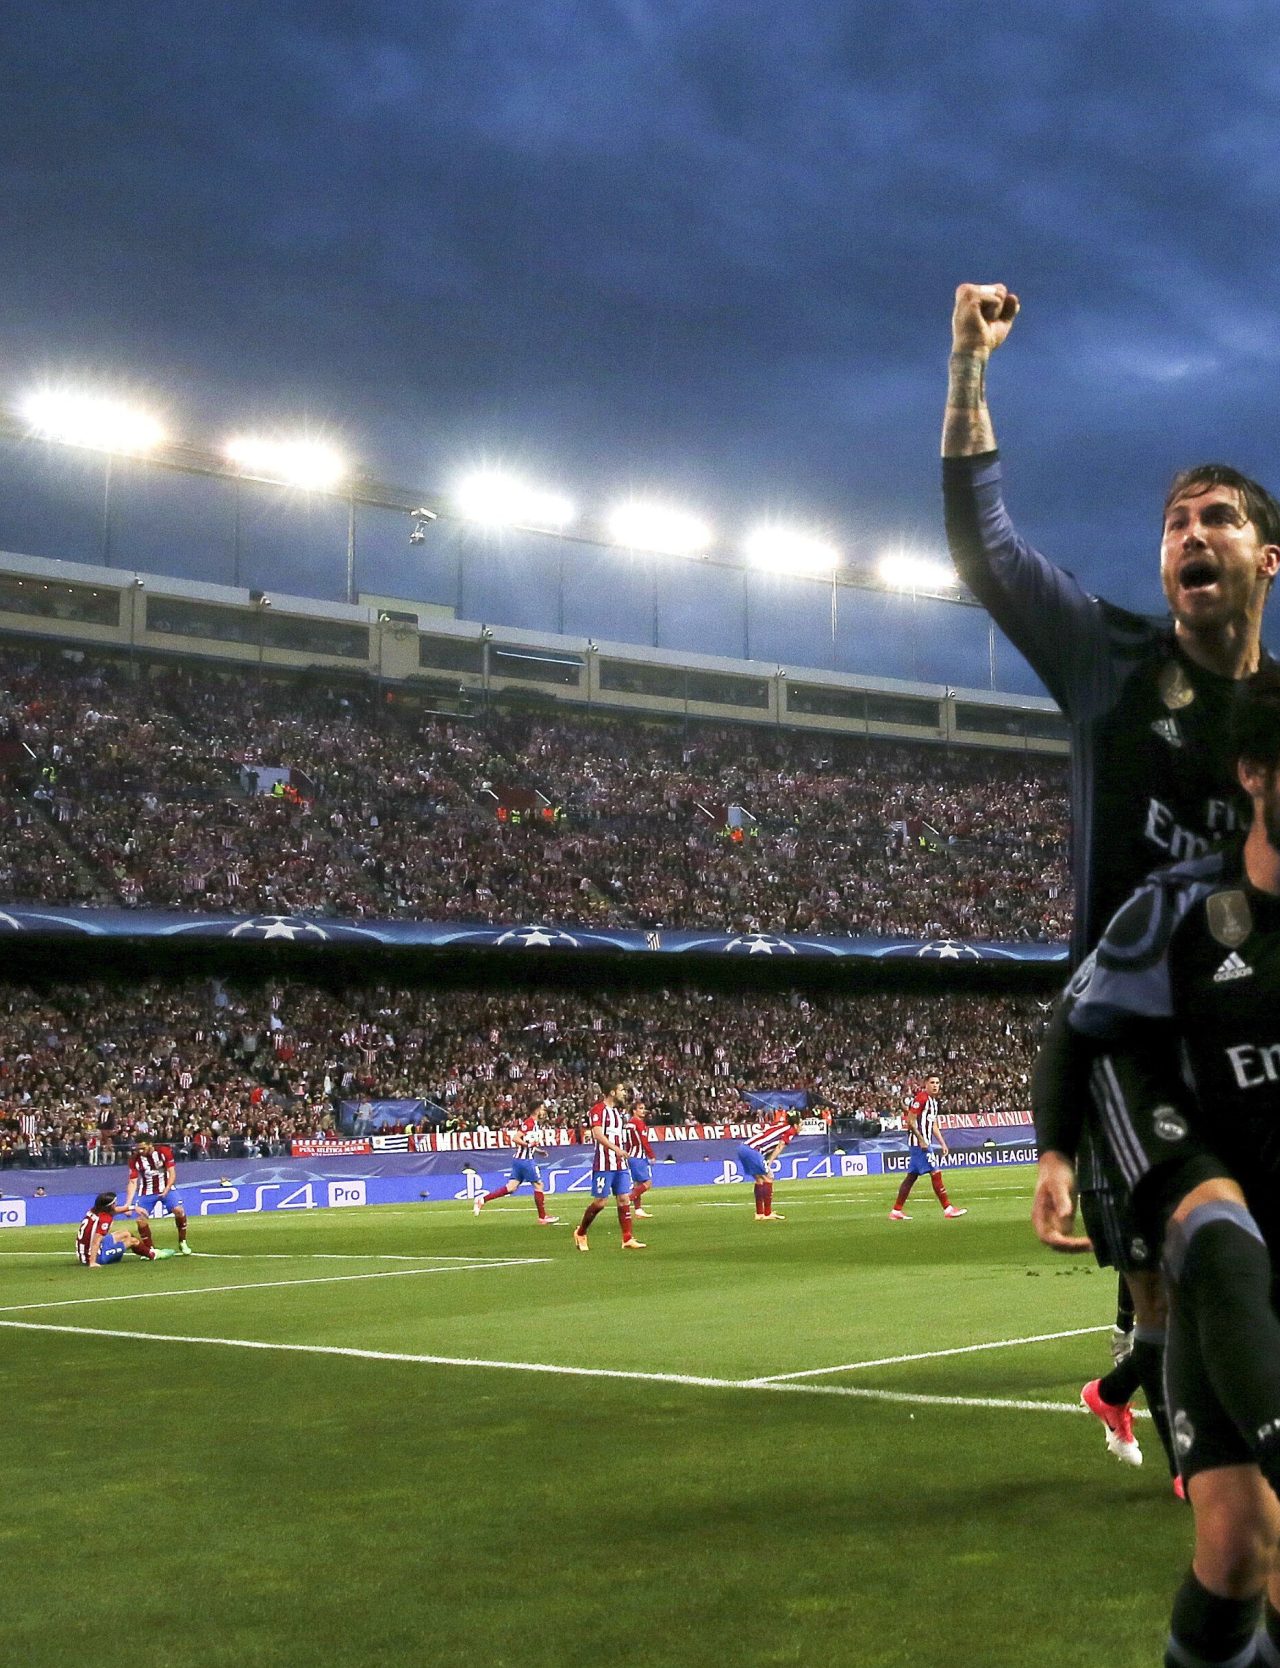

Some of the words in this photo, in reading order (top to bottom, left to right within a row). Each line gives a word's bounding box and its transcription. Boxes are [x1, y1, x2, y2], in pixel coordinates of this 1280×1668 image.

[845, 1160, 864, 1172] Pro
[887, 1156, 911, 1170] UEF
[933, 1151, 993, 1167] HAMPIONS
[996, 1148, 1039, 1163] LEAGUE
[200, 1182, 318, 1216] PS4
[334, 1187, 360, 1201] Pro
[0, 1210, 18, 1222] ro
